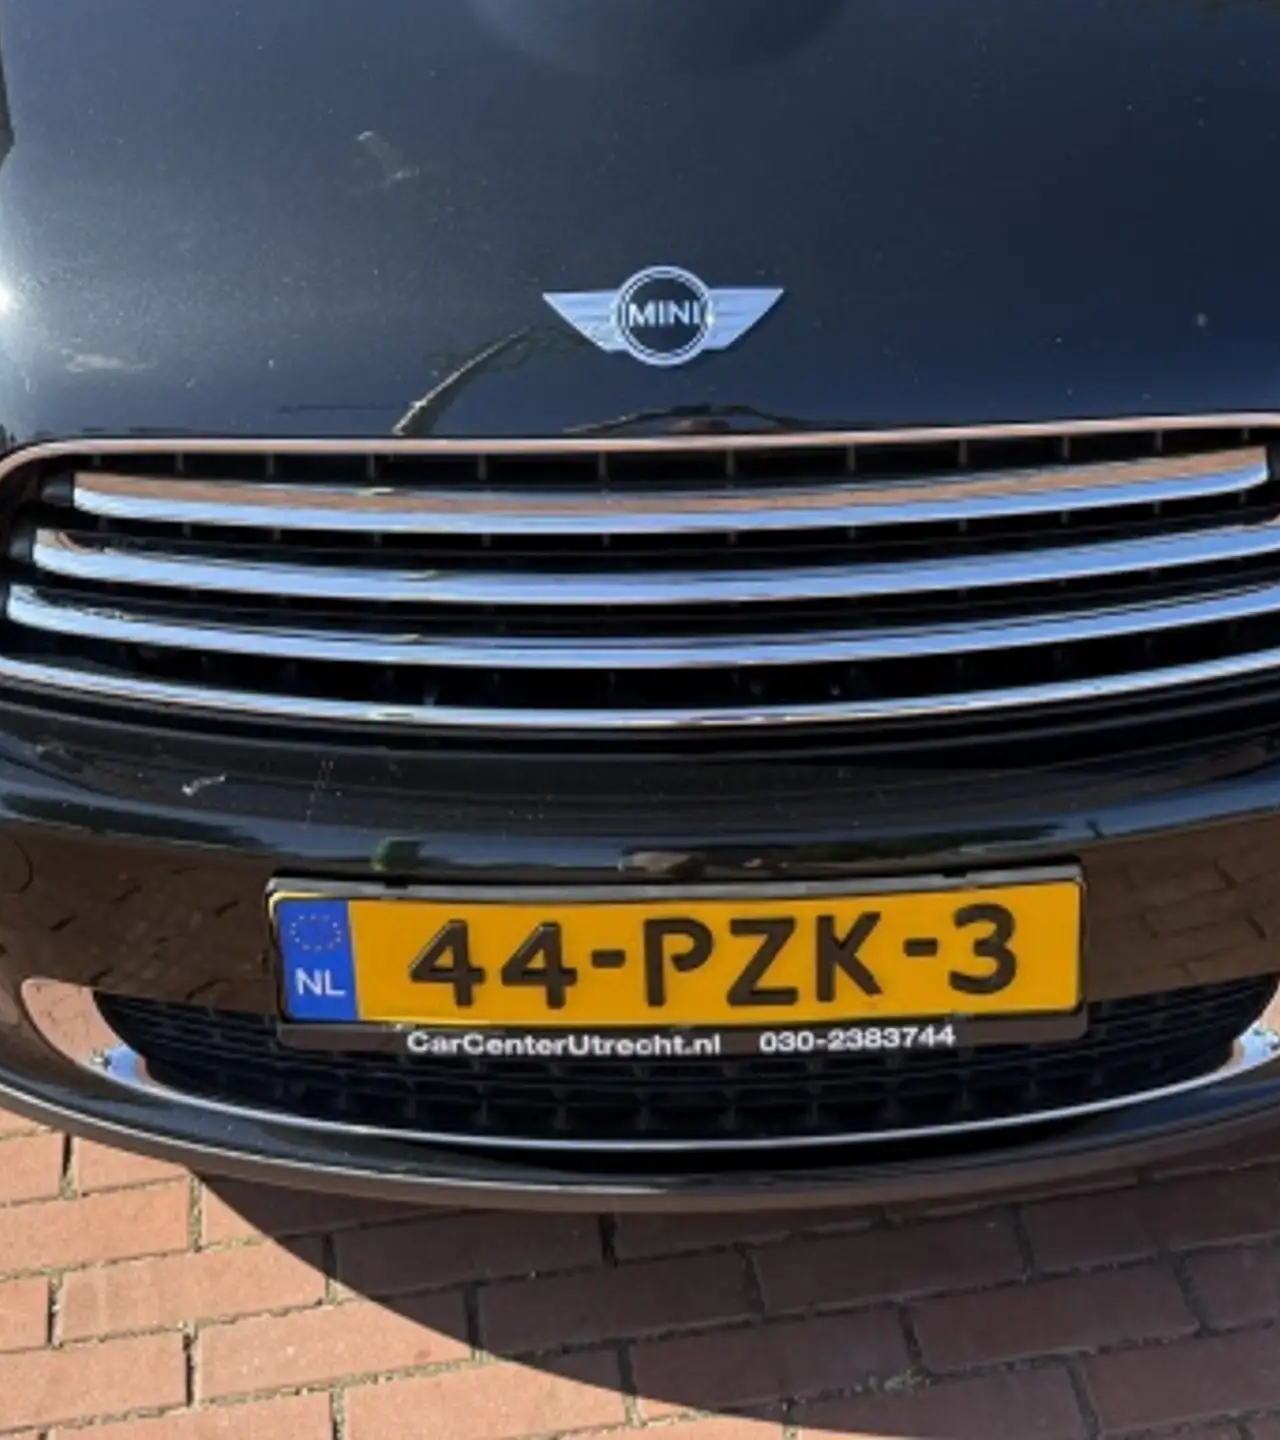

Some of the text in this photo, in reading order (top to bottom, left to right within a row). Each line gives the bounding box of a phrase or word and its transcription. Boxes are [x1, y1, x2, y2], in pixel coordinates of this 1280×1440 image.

[628, 299, 701, 328] MINI
[408, 902, 1017, 1009] 44-PZK-3
[294, 968, 346, 997] NL
[406, 1023, 957, 1057] CarCenterUtrecht.nl 030-2383744
